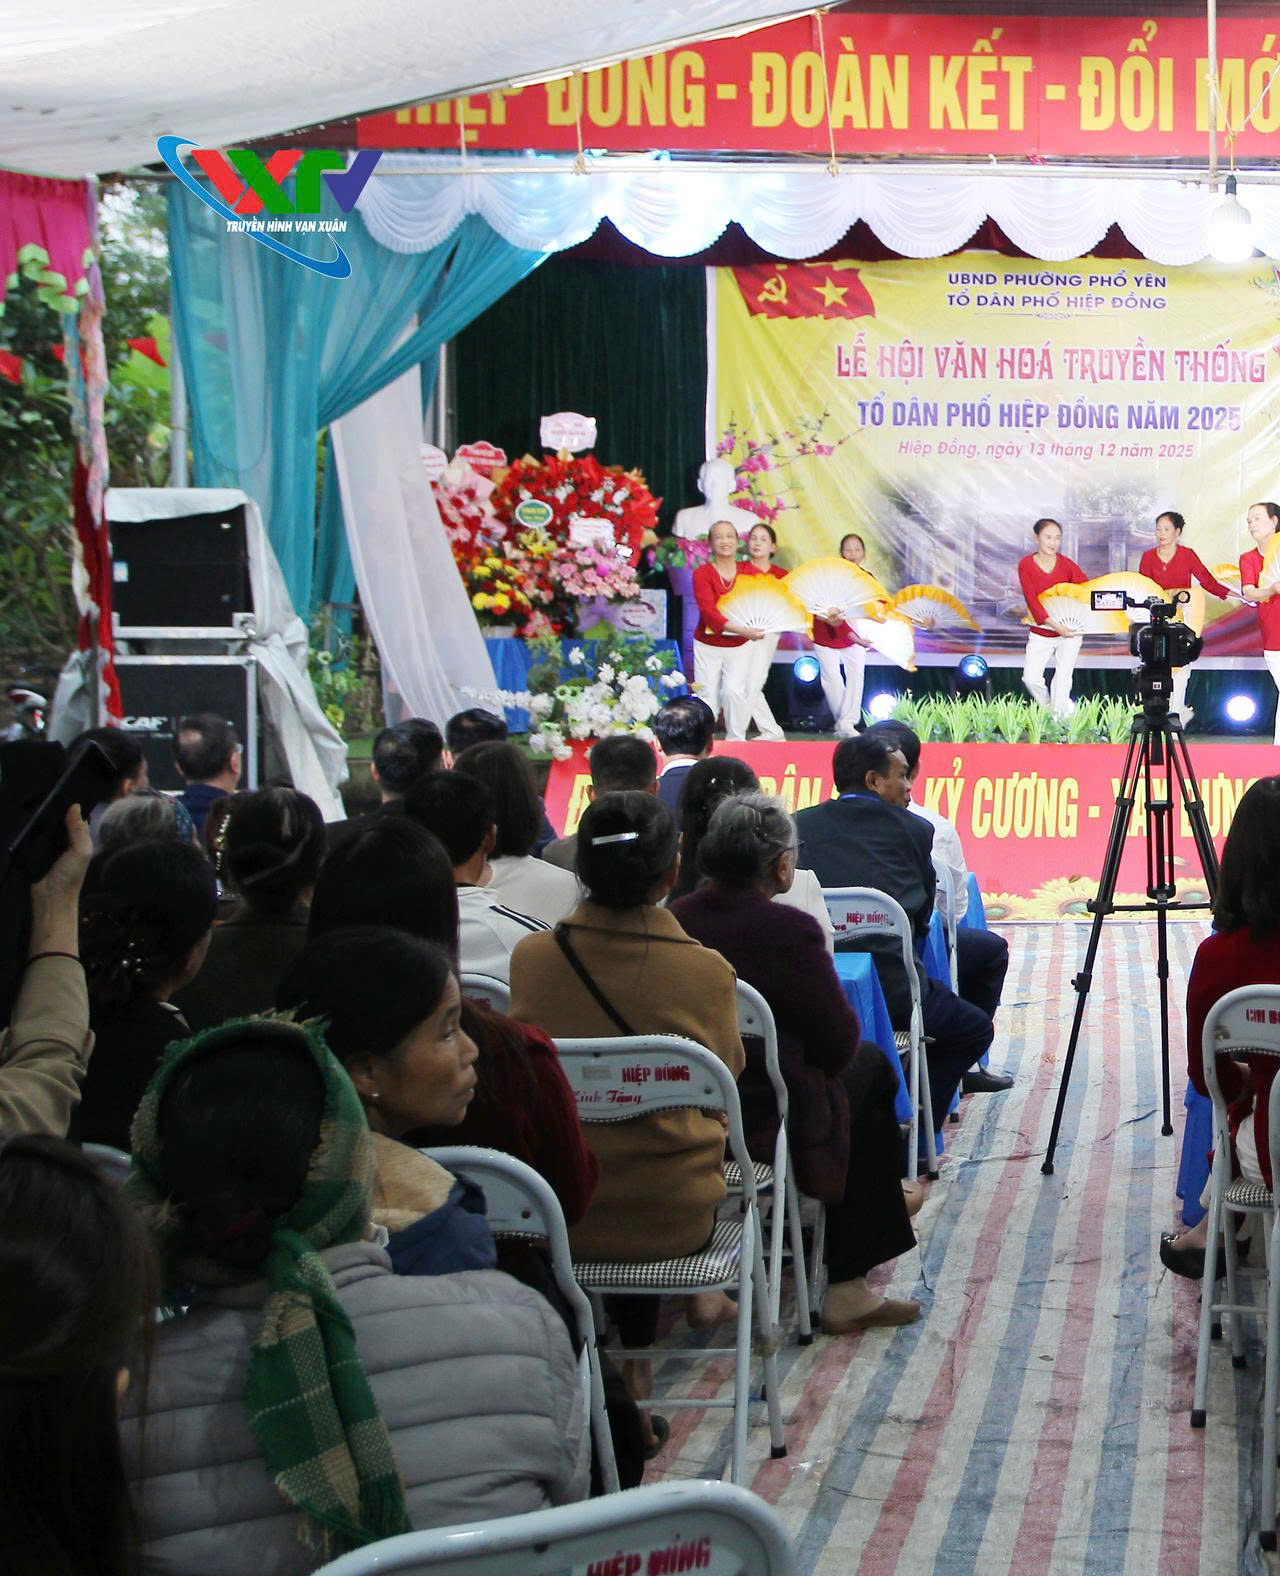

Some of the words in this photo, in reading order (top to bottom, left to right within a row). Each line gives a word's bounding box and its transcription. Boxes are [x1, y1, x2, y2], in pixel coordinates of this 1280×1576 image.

[749, 36, 909, 129] ĐOÀN
[929, 27, 1033, 131] KẾT
[1078, 20, 1174, 132] ĐỔI
[948, 273, 997, 285] UBND
[1004, 271, 1082, 287] PHƯỜNG
[1134, 273, 1166, 288] YÊN
[977, 292, 1015, 307] DÂN
[1022, 291, 1060, 308] PHỐ
[1067, 294, 1105, 311] HIỆP
[837, 332, 867, 377] LỄ
[876, 339, 923, 385] HỘI
[934, 339, 986, 379] VĂN
[996, 340, 1053, 379] HOÁ
[1064, 336, 1165, 384] TRUYỀN
[1175, 339, 1265, 383] THỐNG
[892, 396, 938, 427] DÂN
[947, 393, 991, 427] PHỐ
[999, 398, 1049, 433] HIỆP
[1057, 396, 1119, 429] ĐỒNG
[1128, 400, 1179, 430] NĂM
[1187, 406, 1241, 431] 2025
[986, 441, 1023, 459] ngày
[1029, 442, 1046, 456] 13
[1051, 442, 1093, 460] tháng
[1099, 443, 1116, 457] 12
[1120, 443, 1153, 457] năm
[1158, 444, 1194, 458] 2025
[971, 771, 1080, 839] CƯƠNG
